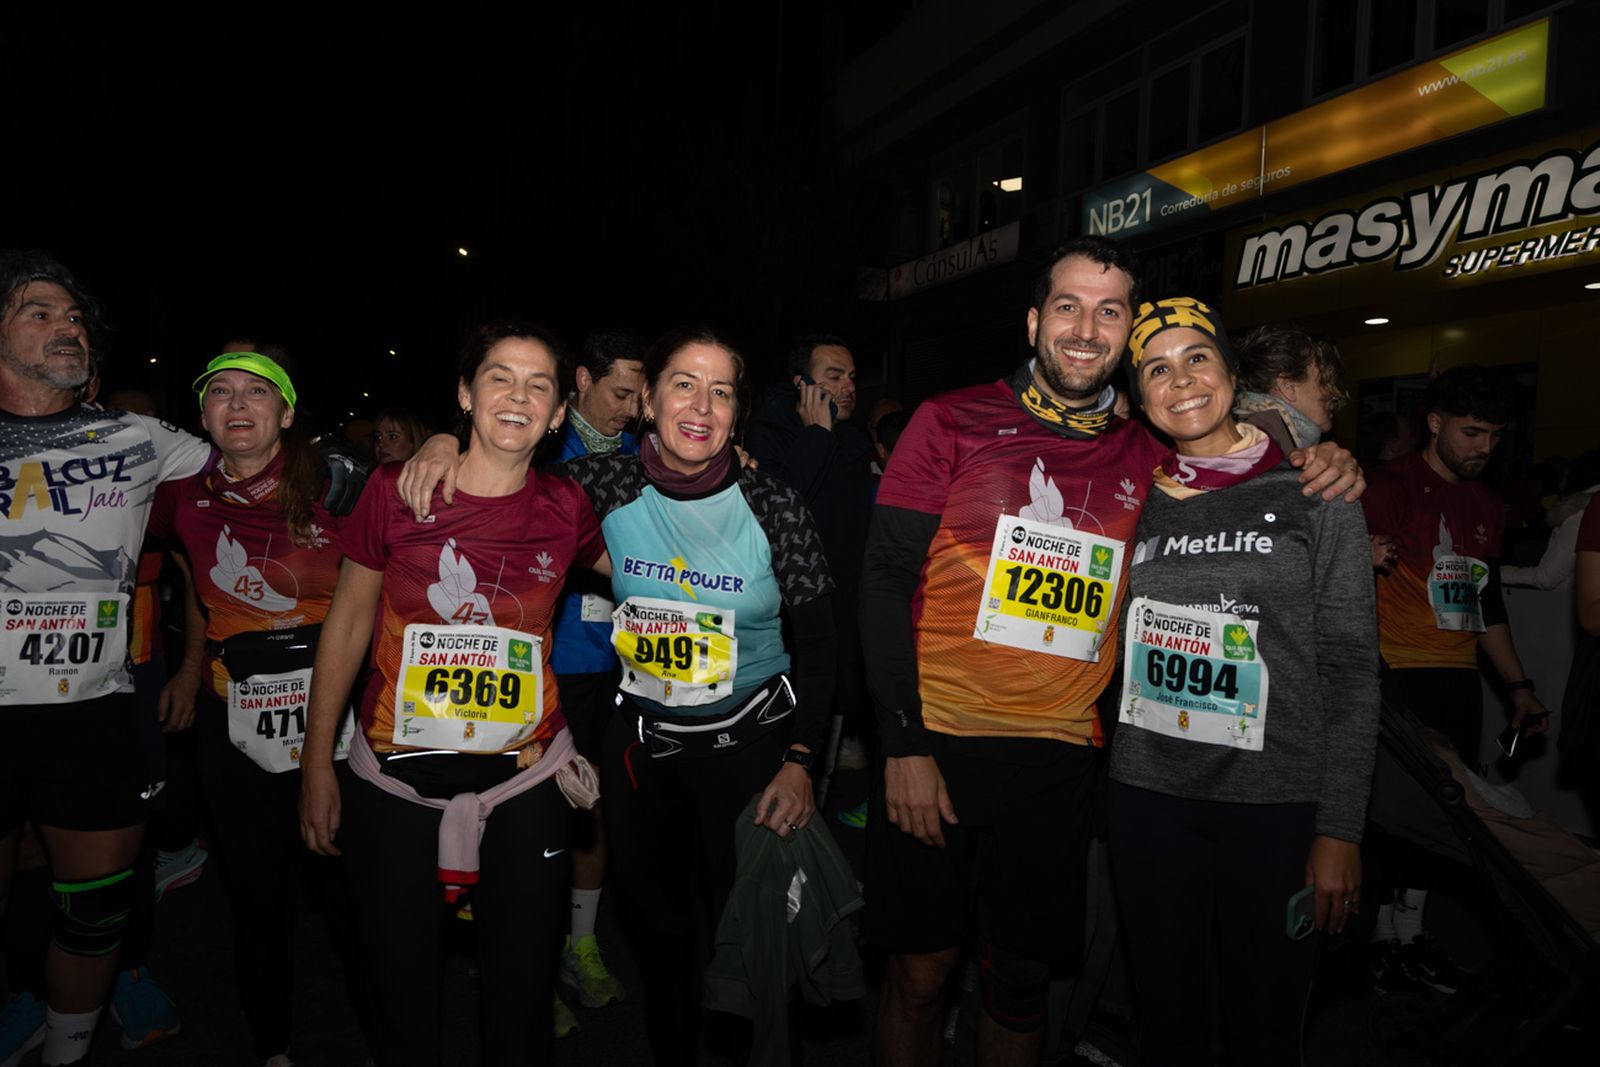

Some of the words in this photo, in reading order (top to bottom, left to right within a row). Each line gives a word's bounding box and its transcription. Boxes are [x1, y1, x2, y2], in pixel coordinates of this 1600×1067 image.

[1222, 183, 1237, 197] de
[1240, 165, 1291, 189] seguros
[1088, 188, 1152, 236] NB21
[80, 486, 128, 522] Jaén
[1025, 535, 1064, 555] NOCHE
[1066, 544, 1082, 558] DE
[1163, 531, 1273, 556] MetLife
[1008, 547, 1035, 564] SAN
[1037, 555, 1080, 574] ANTÓN
[623, 557, 675, 583] BETTA
[679, 569, 744, 593] POWER
[234, 575, 265, 601] 43
[1006, 565, 1104, 618] 12306
[25, 605, 68, 616] NOCHE
[70, 604, 87, 616] DE
[1025, 608, 1078, 627] GIANFRANCO
[6, 618, 36, 631] SAN
[39, 616, 87, 631] ANTÓN
[624, 620, 643, 634] SAN
[1153, 617, 1193, 635] NOCHE
[1195, 625, 1212, 639] DE
[19, 632, 105, 665] 4207
[437, 638, 479, 650] NOCHE
[482, 639, 499, 652] DE
[634, 636, 709, 670] 9491
[1141, 630, 1164, 647] SAN
[1165, 635, 1211, 656] ANTÓN
[418, 652, 448, 666] SAN
[450, 651, 497, 668] ANTÓN
[1147, 649, 1239, 700] 6994
[252, 683, 288, 695] NOCHE
[291, 681, 305, 691] DE
[424, 667, 521, 709] 6369
[240, 698, 263, 710] SAN
[265, 692, 306, 709] ANTÓN
[455, 708, 488, 719] Victoria
[1156, 691, 1172, 704] José
[1174, 695, 1218, 711] Francisco
